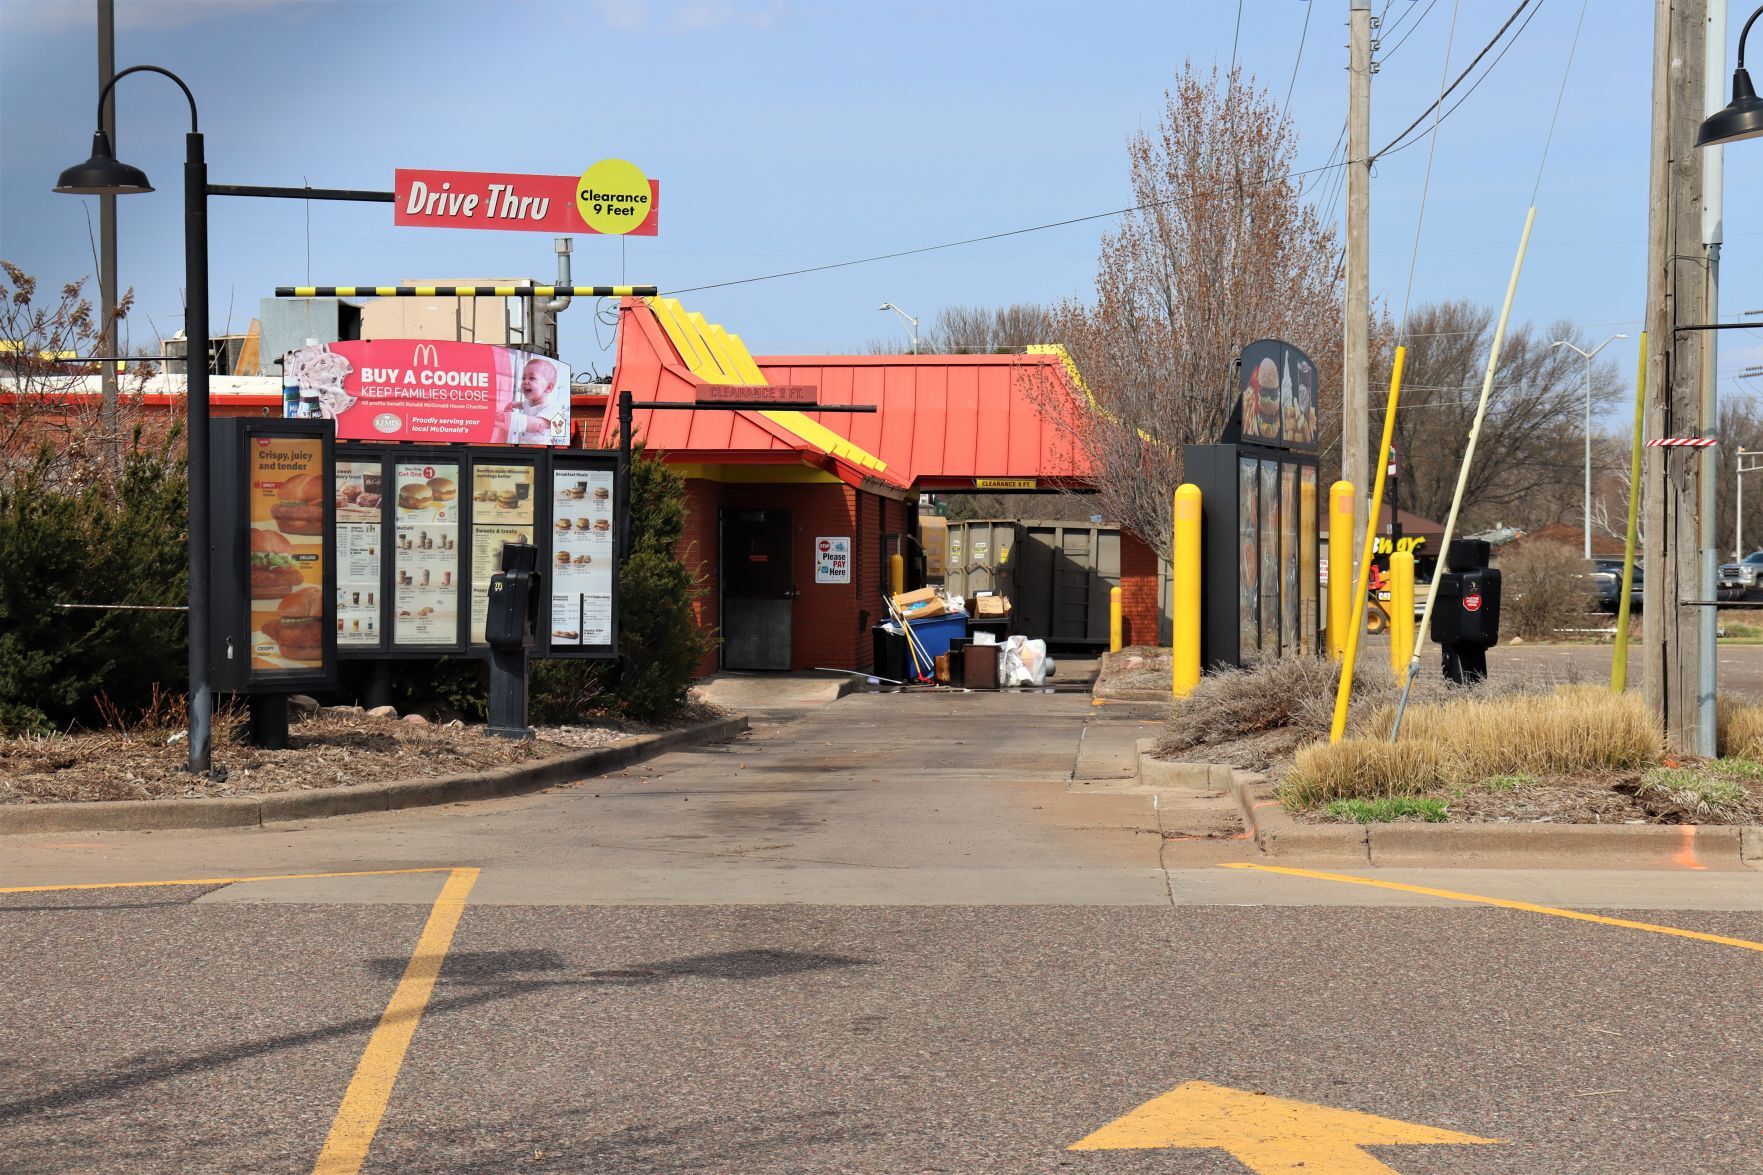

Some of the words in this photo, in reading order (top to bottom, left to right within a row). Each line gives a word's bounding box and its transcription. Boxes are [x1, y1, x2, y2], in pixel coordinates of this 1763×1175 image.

[407, 181, 478, 216] Drive
[487, 184, 550, 220] Thru
[581, 190, 647, 203] Clearance
[593, 204, 602, 215] 9
[607, 205, 634, 215] Feet
[361, 368, 399, 383] BUY
[404, 370, 416, 384] A
[420, 370, 489, 387] COOKIE
[361, 386, 392, 397] KEEP
[395, 388, 447, 400] FAMILIES
[450, 390, 488, 401] CLOSE
[710, 386, 775, 398] CLEARANCE
[780, 388, 785, 398] 9
[439, 418, 464, 426] serving
[259, 450, 290, 461] Crispy,
[291, 450, 313, 462] juicy
